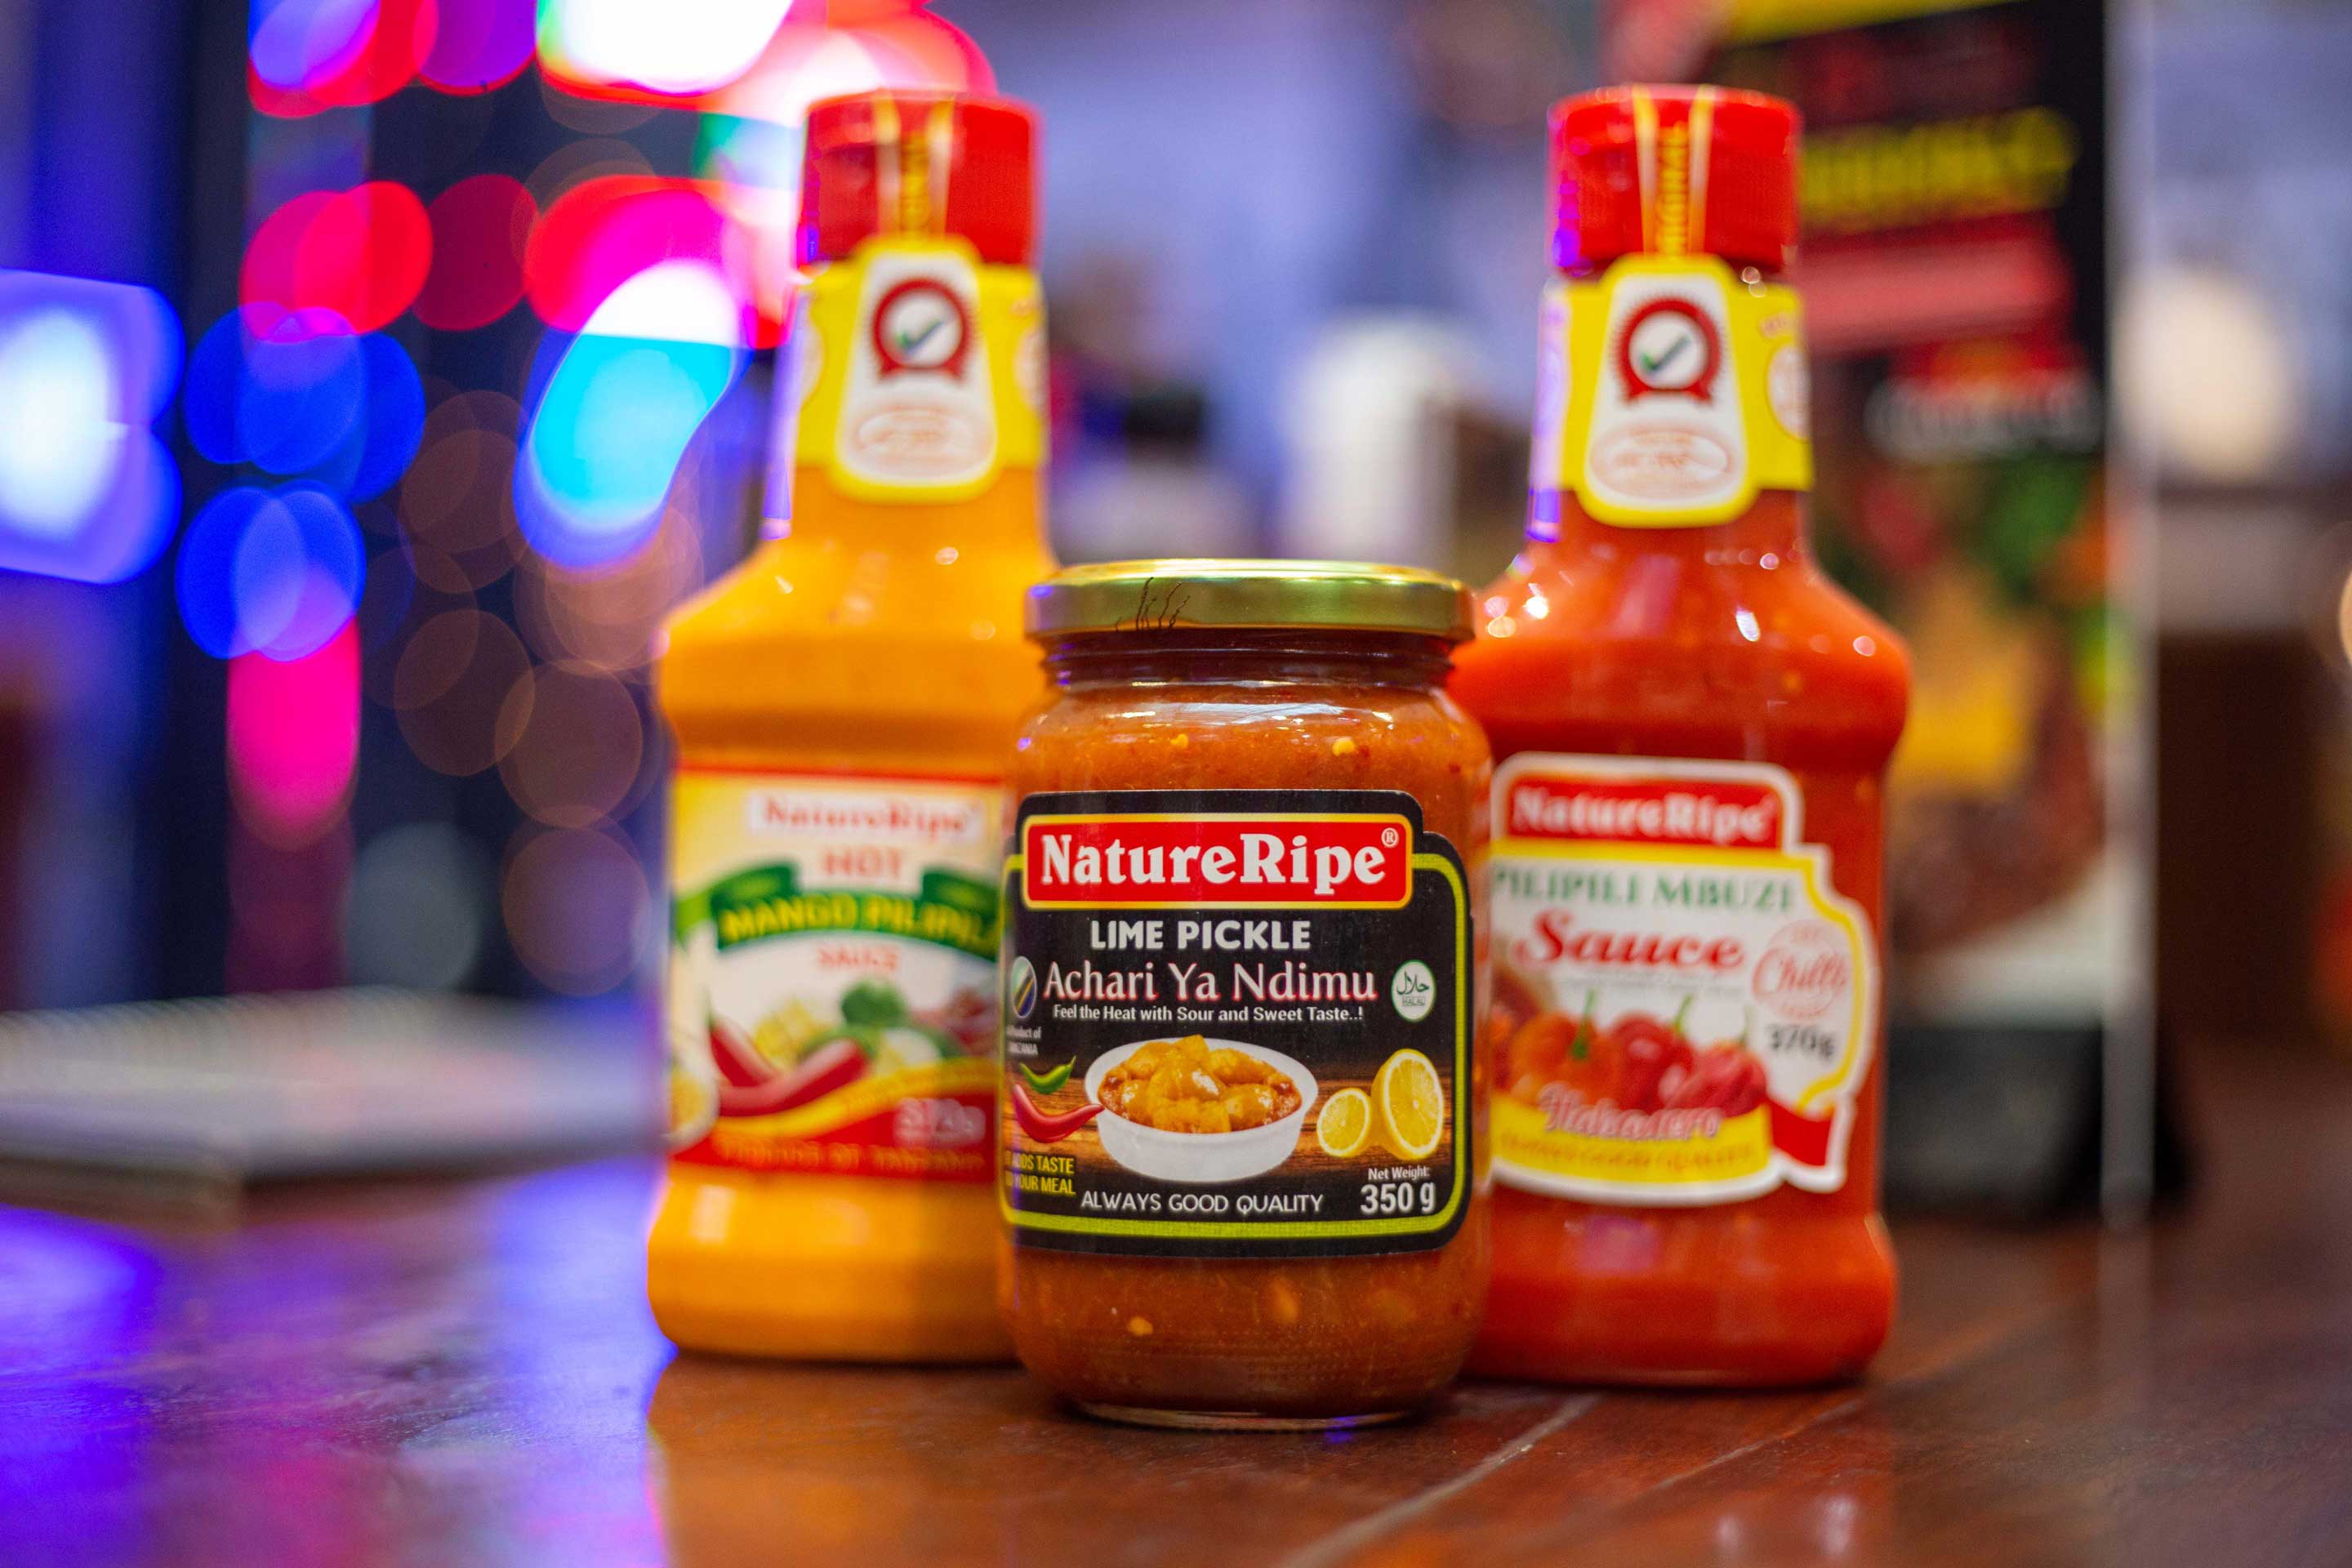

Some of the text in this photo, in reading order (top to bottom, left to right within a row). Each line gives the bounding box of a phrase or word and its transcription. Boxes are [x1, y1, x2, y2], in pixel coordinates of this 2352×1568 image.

[1513, 786, 1767, 844] NatureRipe
[825, 846, 902, 876] HOT
[1655, 871, 1792, 911] MBUZI
[720, 893, 856, 942] MANGO
[1090, 920, 1311, 951] LIME PICKLE
[1513, 908, 1744, 970] Sauce
[1043, 960, 1379, 1002] Achari Ya Ndimu
[1396, 970, 1430, 996] حلال
[1053, 1004, 1076, 1018] Feel
[1079, 1004, 1100, 1019] the
[1103, 1005, 1136, 1020] Heat
[1140, 1005, 1172, 1020] with
[1177, 1006, 1214, 1021] Sour
[1218, 1006, 1249, 1021] and
[1253, 1006, 1302, 1021] Sweet
[1033, 1026, 1041, 1039] of
[1036, 1156, 1075, 1174] TASTE
[1368, 1166, 1430, 1182] Net Weight:
[1041, 1177, 1076, 1195] MEAL
[1360, 1181, 1436, 1214] 350 g
[1080, 1191, 1324, 1214] ALWAYS GOOD QUALITY
